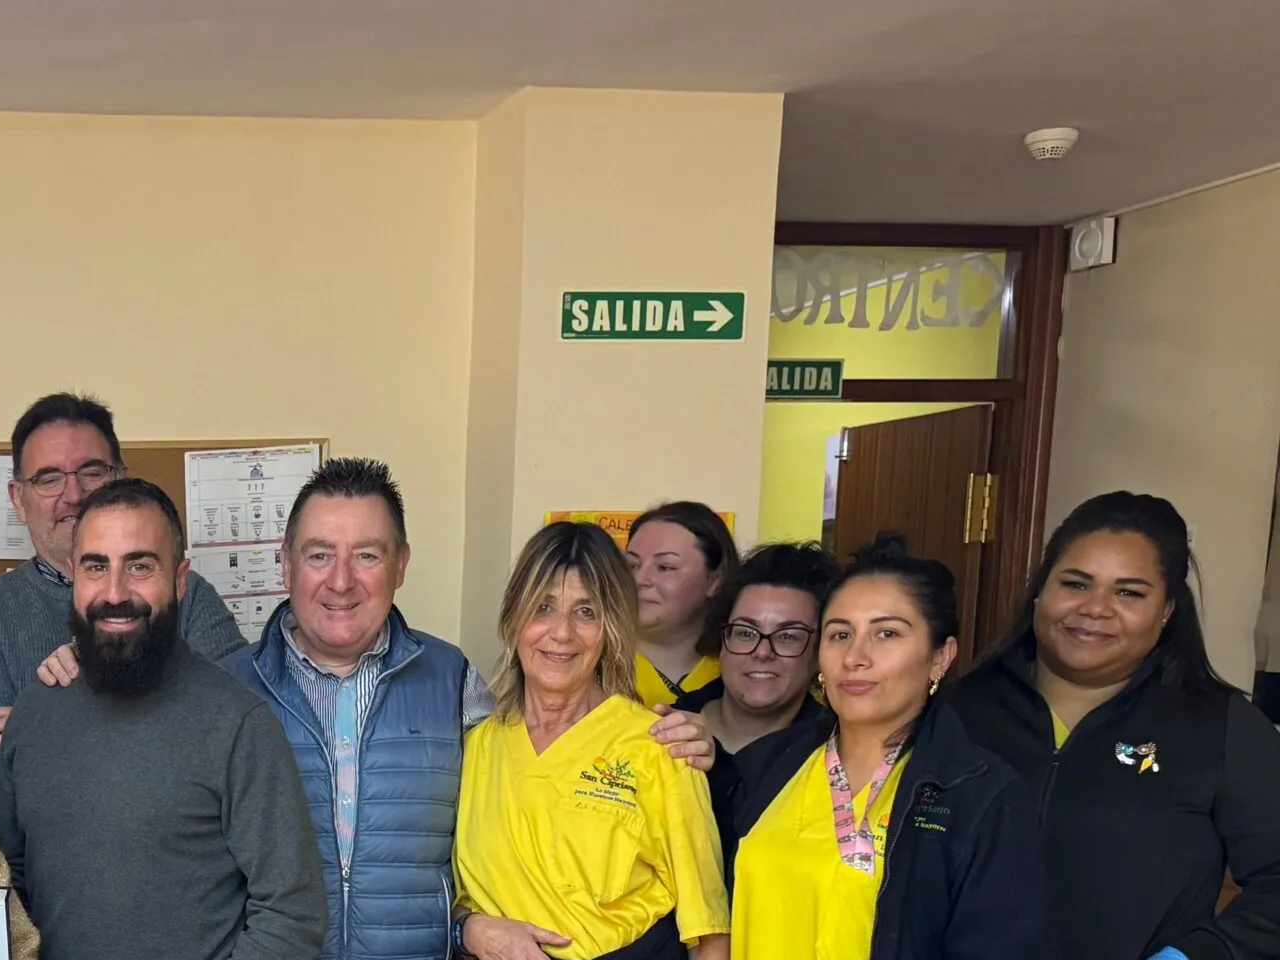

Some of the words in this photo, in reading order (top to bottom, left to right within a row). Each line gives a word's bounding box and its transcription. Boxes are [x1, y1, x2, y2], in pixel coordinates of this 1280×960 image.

[571, 299, 686, 333] SALIDA
[766, 366, 833, 391] ALIDA
[580, 771, 598, 782] San
[600, 777, 637, 795] Cipriano
